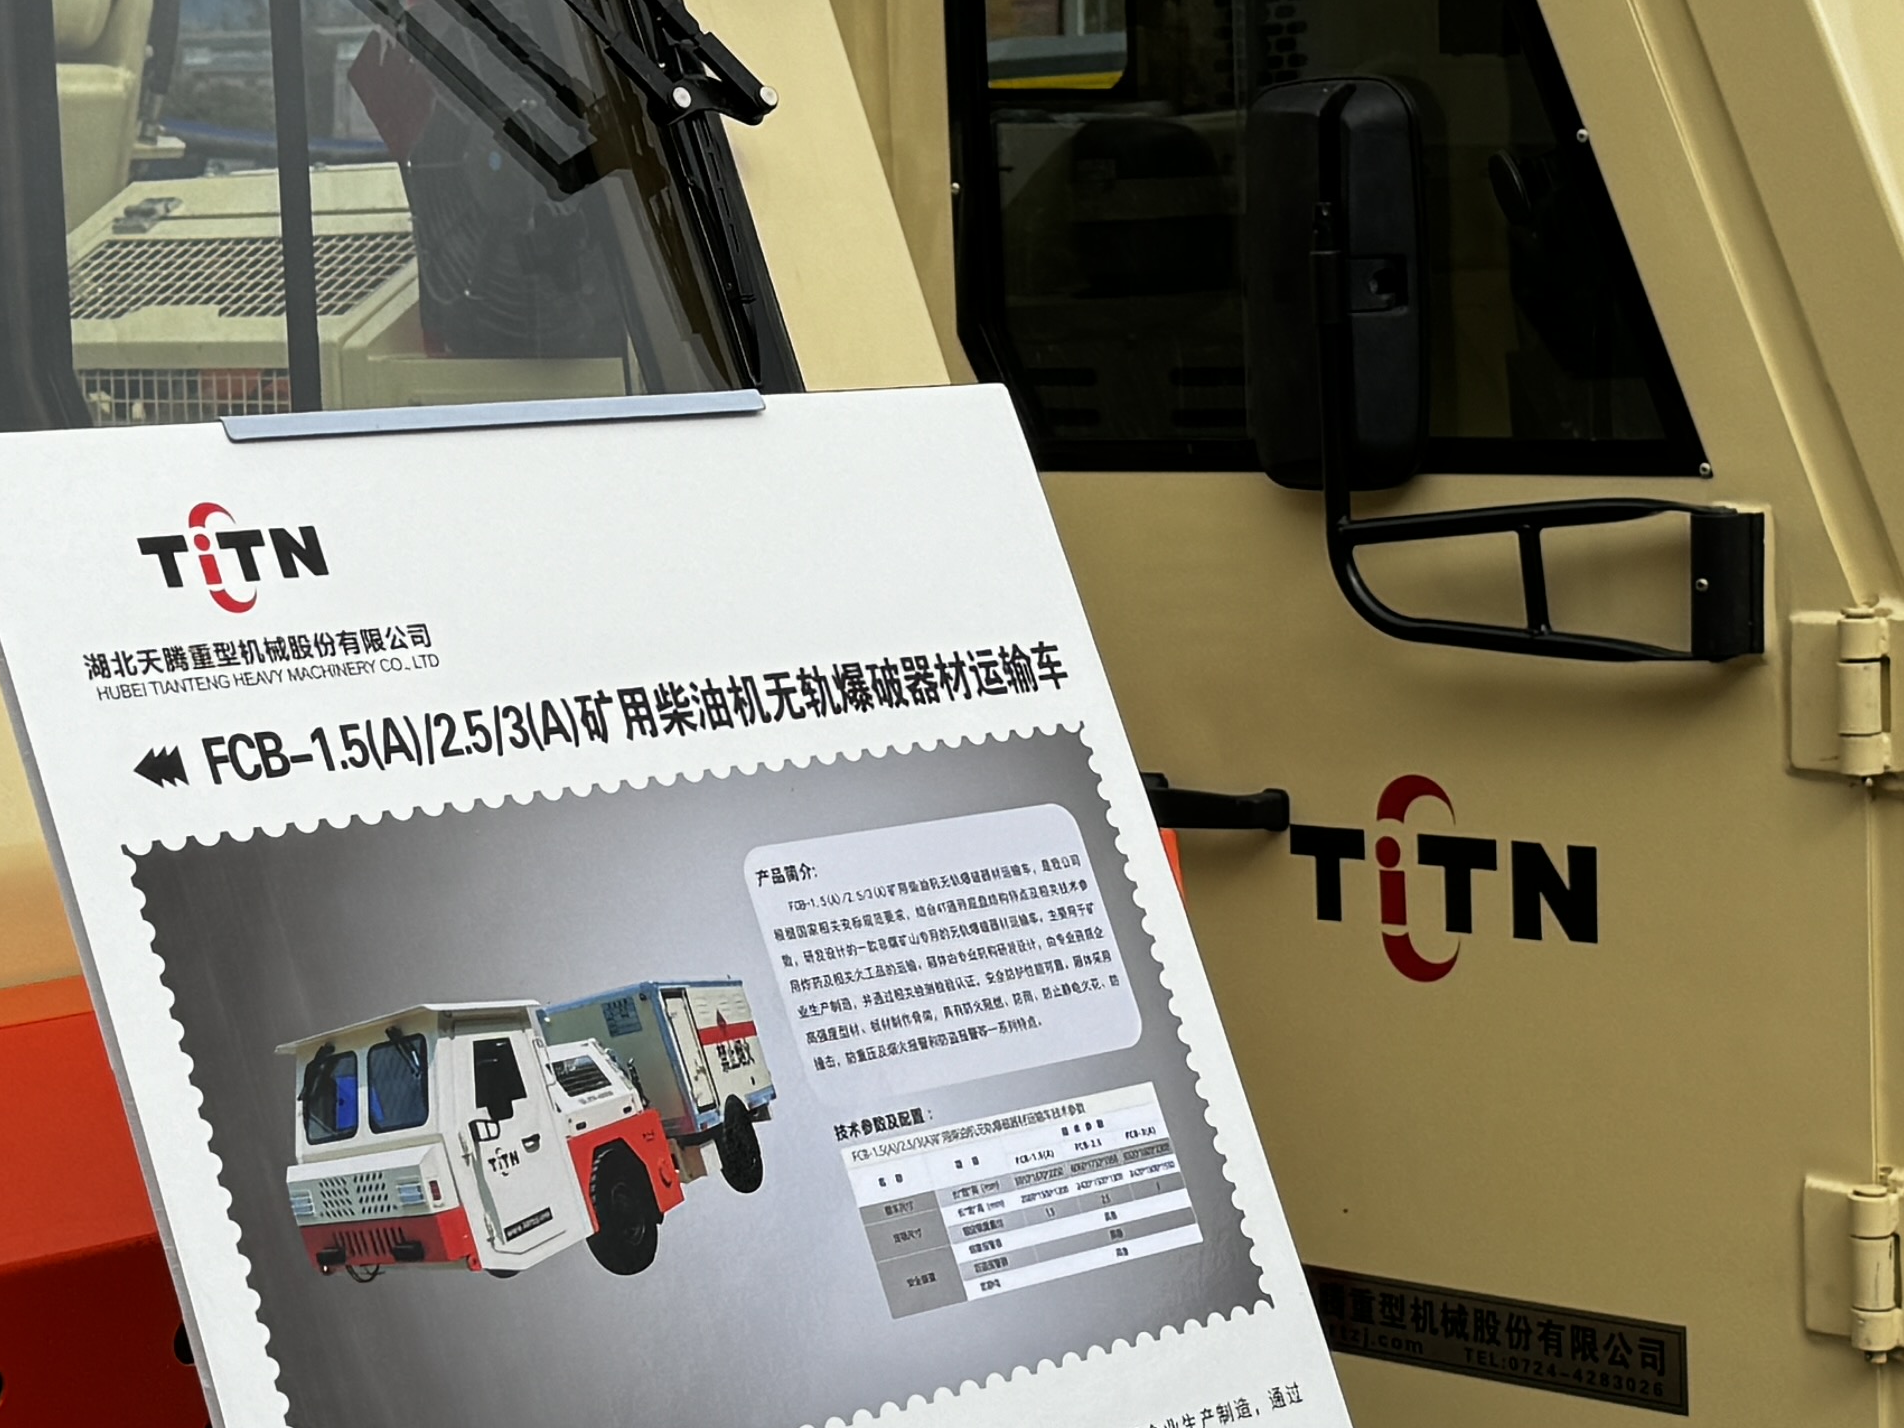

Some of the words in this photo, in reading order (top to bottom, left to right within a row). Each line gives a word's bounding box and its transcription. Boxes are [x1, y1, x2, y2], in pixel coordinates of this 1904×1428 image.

[82, 623, 431, 679] 湖北天腾重型机械股份有限公司
[96, 682, 147, 700] HUBEI
[148, 674, 230, 695] TIANTENG
[232, 669, 282, 686] HEAVY
[286, 659, 375, 681] MACHINERY
[411, 653, 439, 668] LTD
[1289, 821, 1599, 944] TiTN
[1464, 1347, 1664, 1397] TEL:0724-4283026
